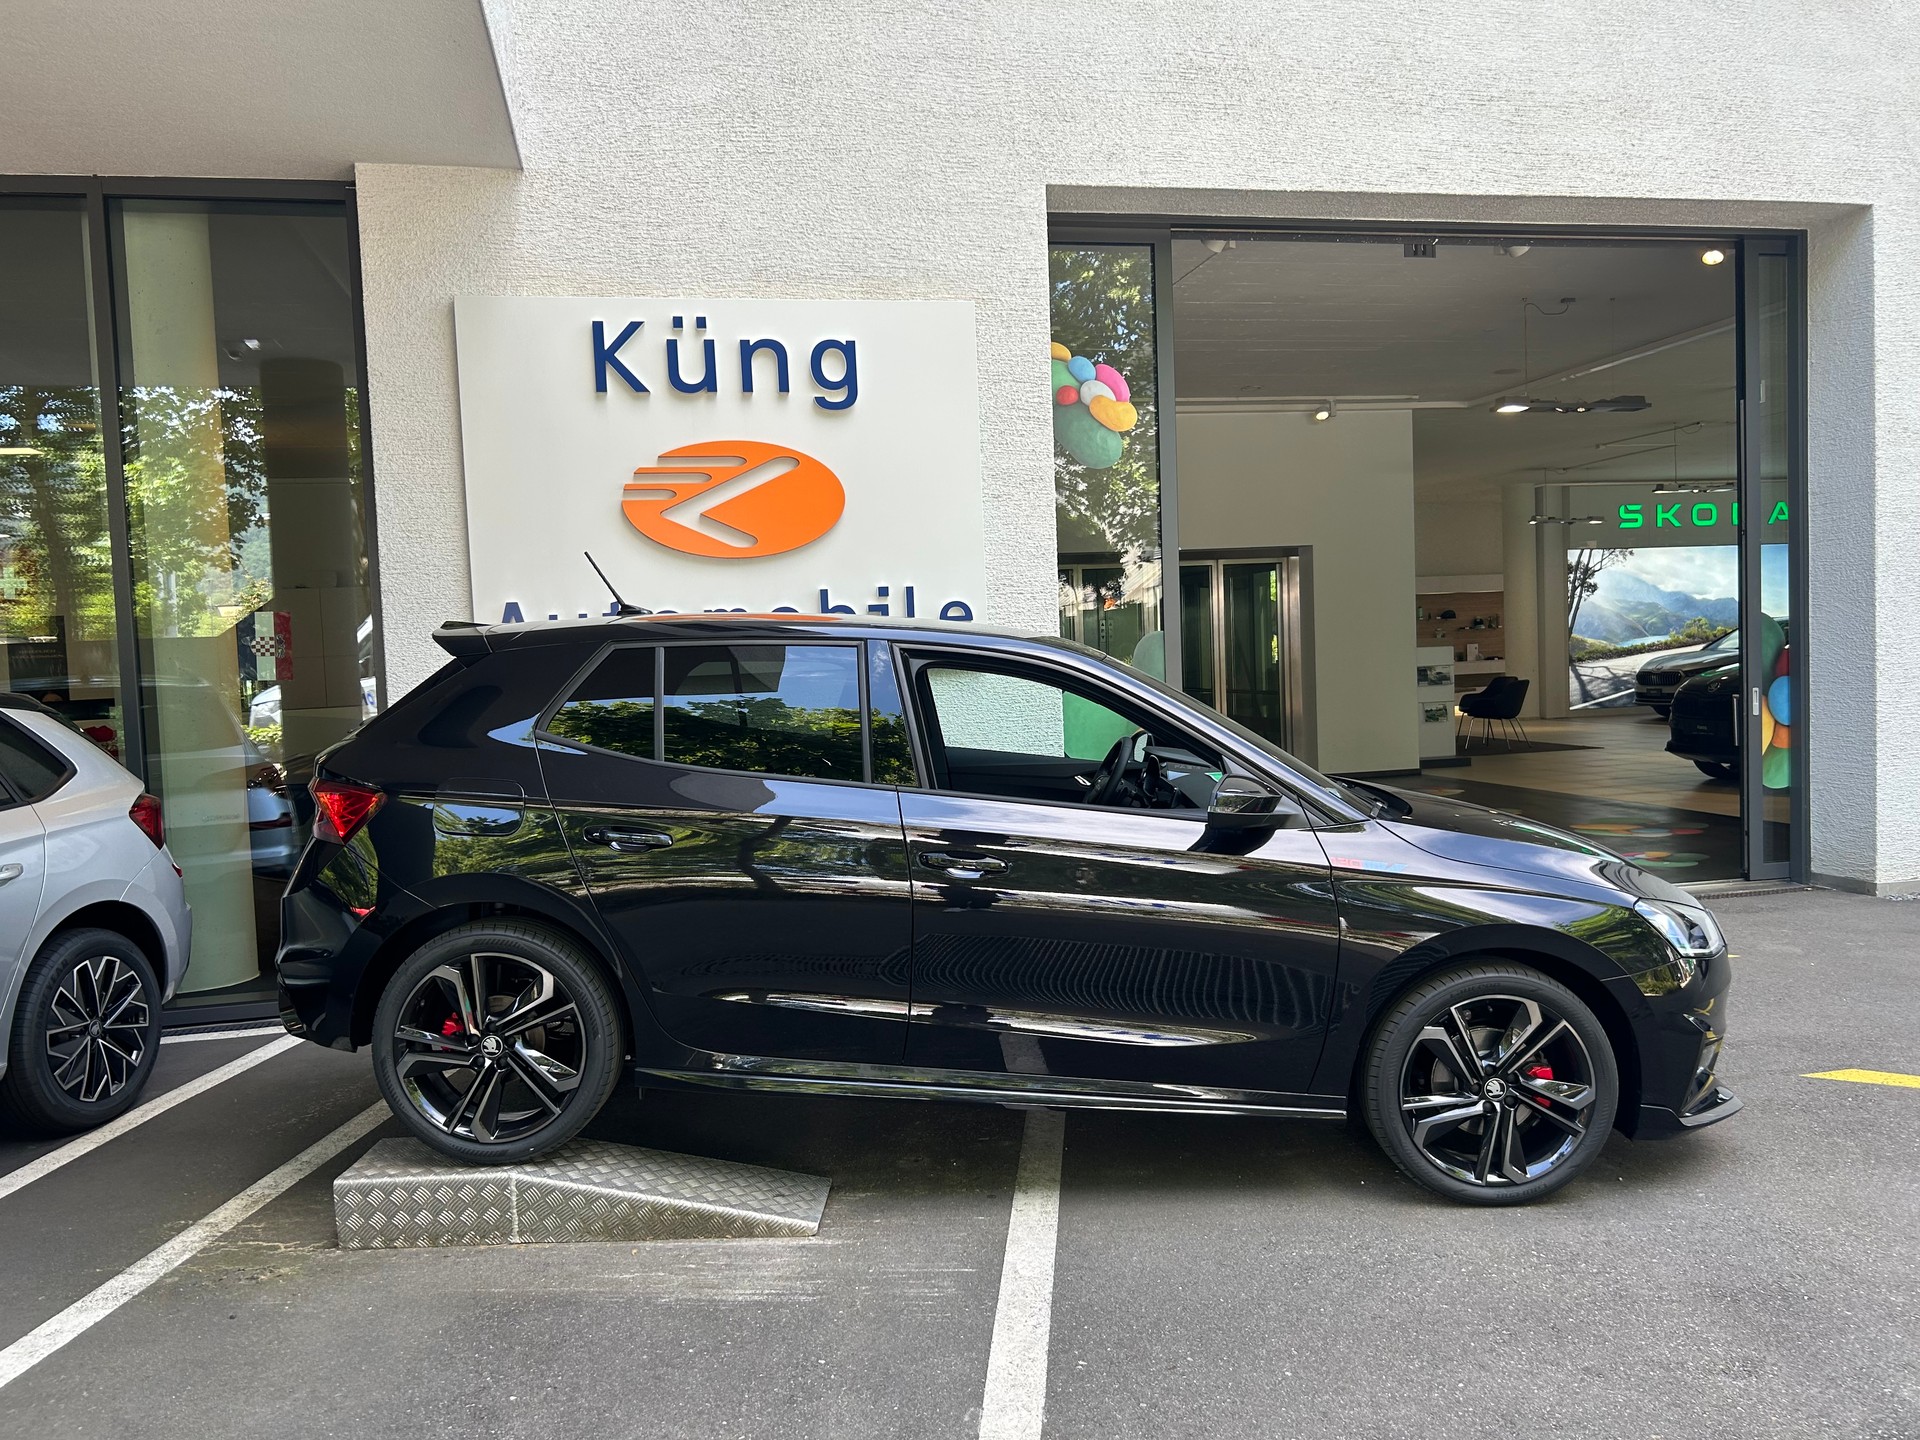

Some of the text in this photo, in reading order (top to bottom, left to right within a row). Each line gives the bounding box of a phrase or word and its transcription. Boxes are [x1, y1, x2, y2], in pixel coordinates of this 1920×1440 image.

[592, 316, 858, 410] Küng
[1618, 501, 1789, 529] SKOA
[502, 586, 973, 623] Abile
